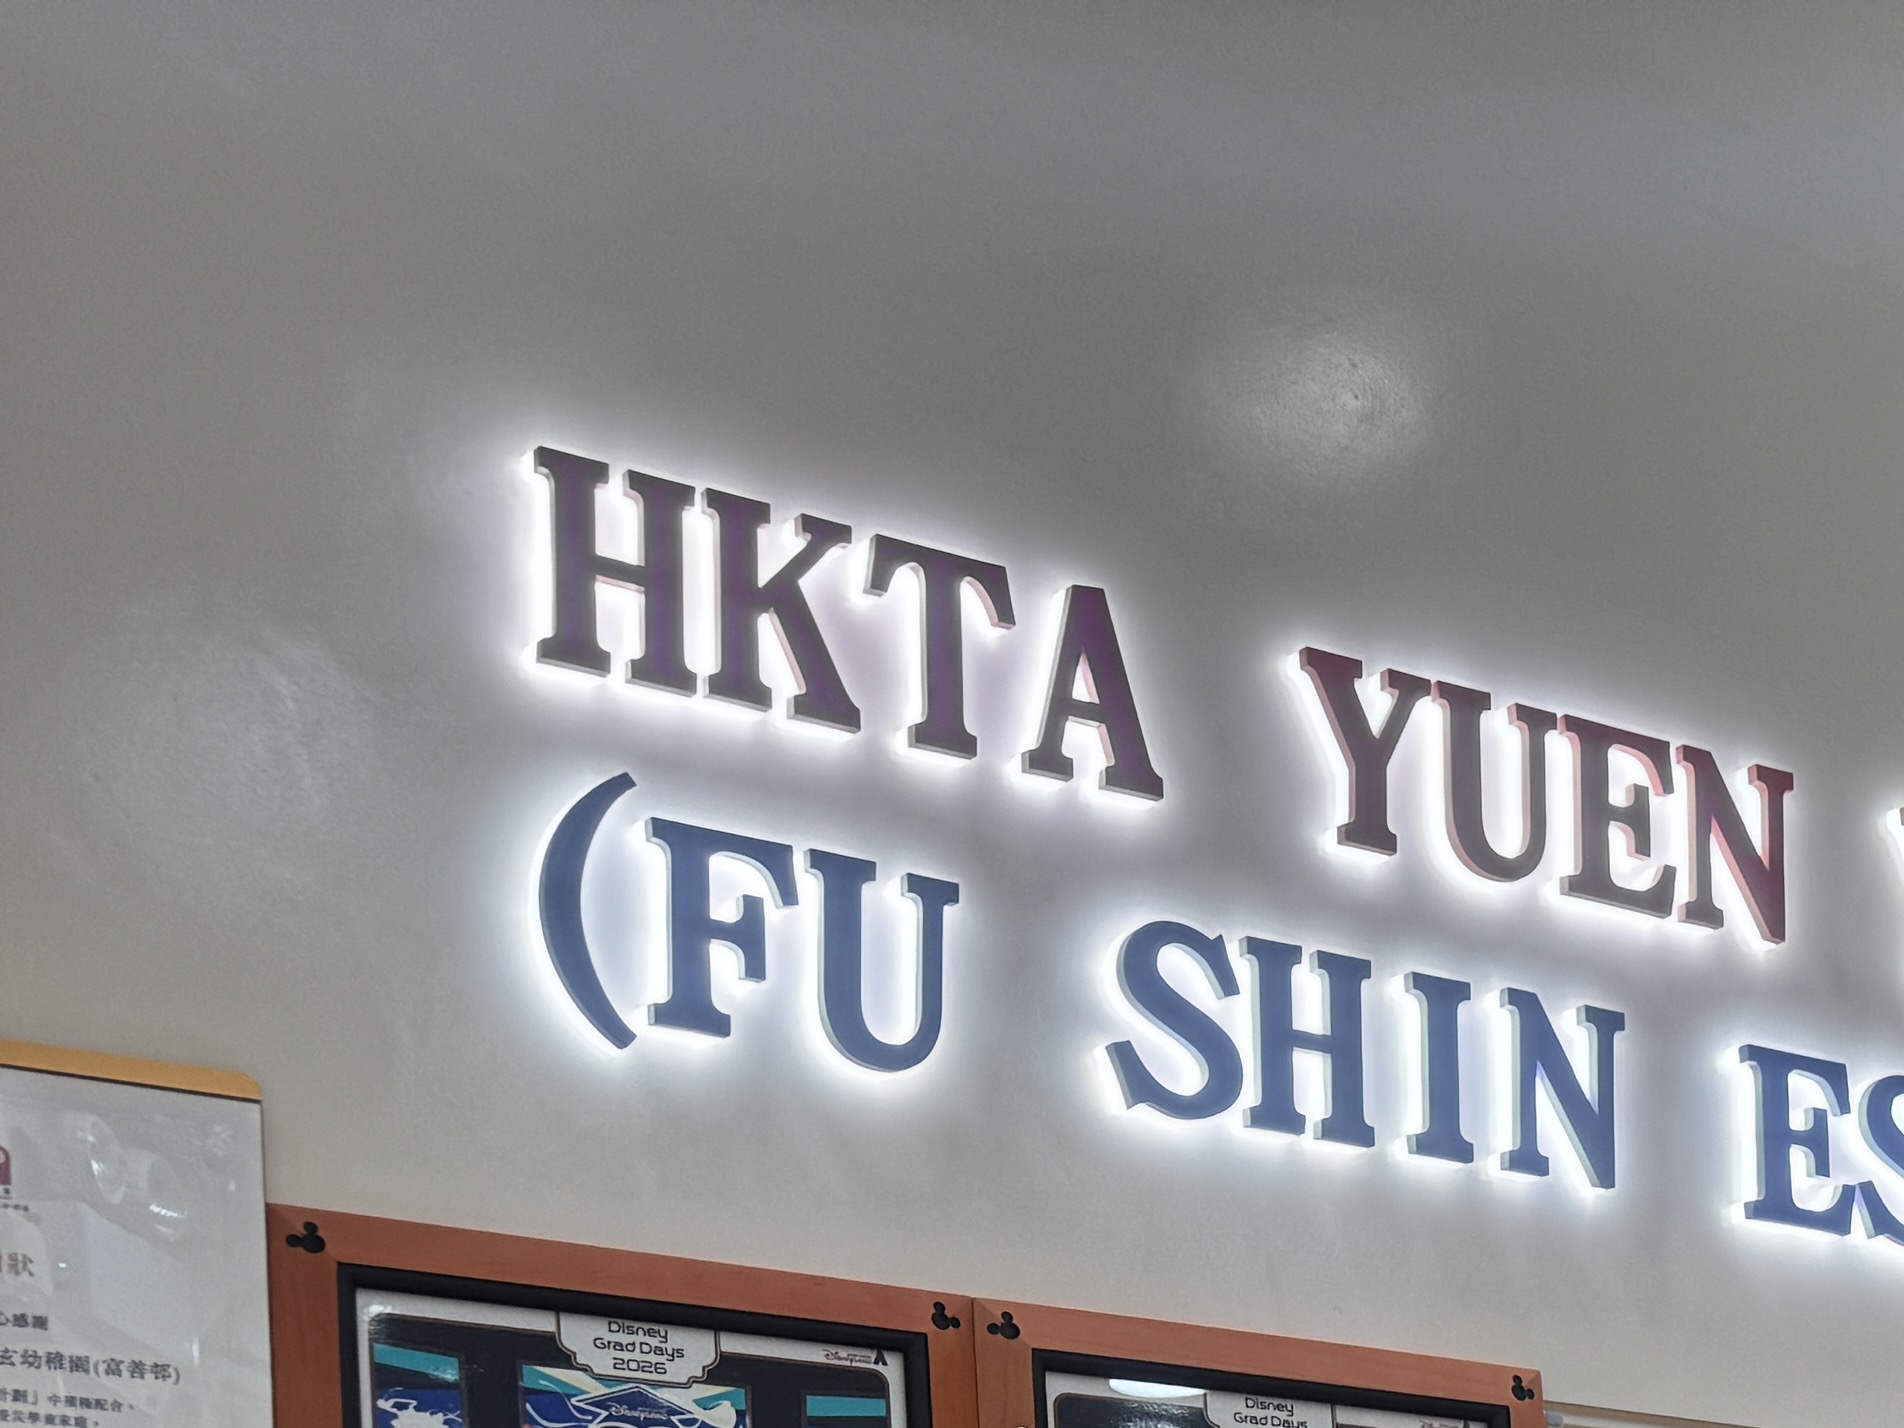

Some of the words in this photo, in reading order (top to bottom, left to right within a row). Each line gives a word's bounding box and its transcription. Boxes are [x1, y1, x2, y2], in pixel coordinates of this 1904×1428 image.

[531, 445, 1164, 802] HKTA
[1300, 647, 1794, 945] YUEN
[537, 771, 960, 1075] (FU
[1106, 920, 1625, 1180] SHIN
[607, 1320, 669, 1344] Disney
[593, 1337, 637, 1353] Grad
[639, 1342, 685, 1361] Days
[612, 1357, 668, 1375] 2026
[1245, 1396, 1295, 1416] Disney
[1233, 1411, 1268, 1428] Grad
